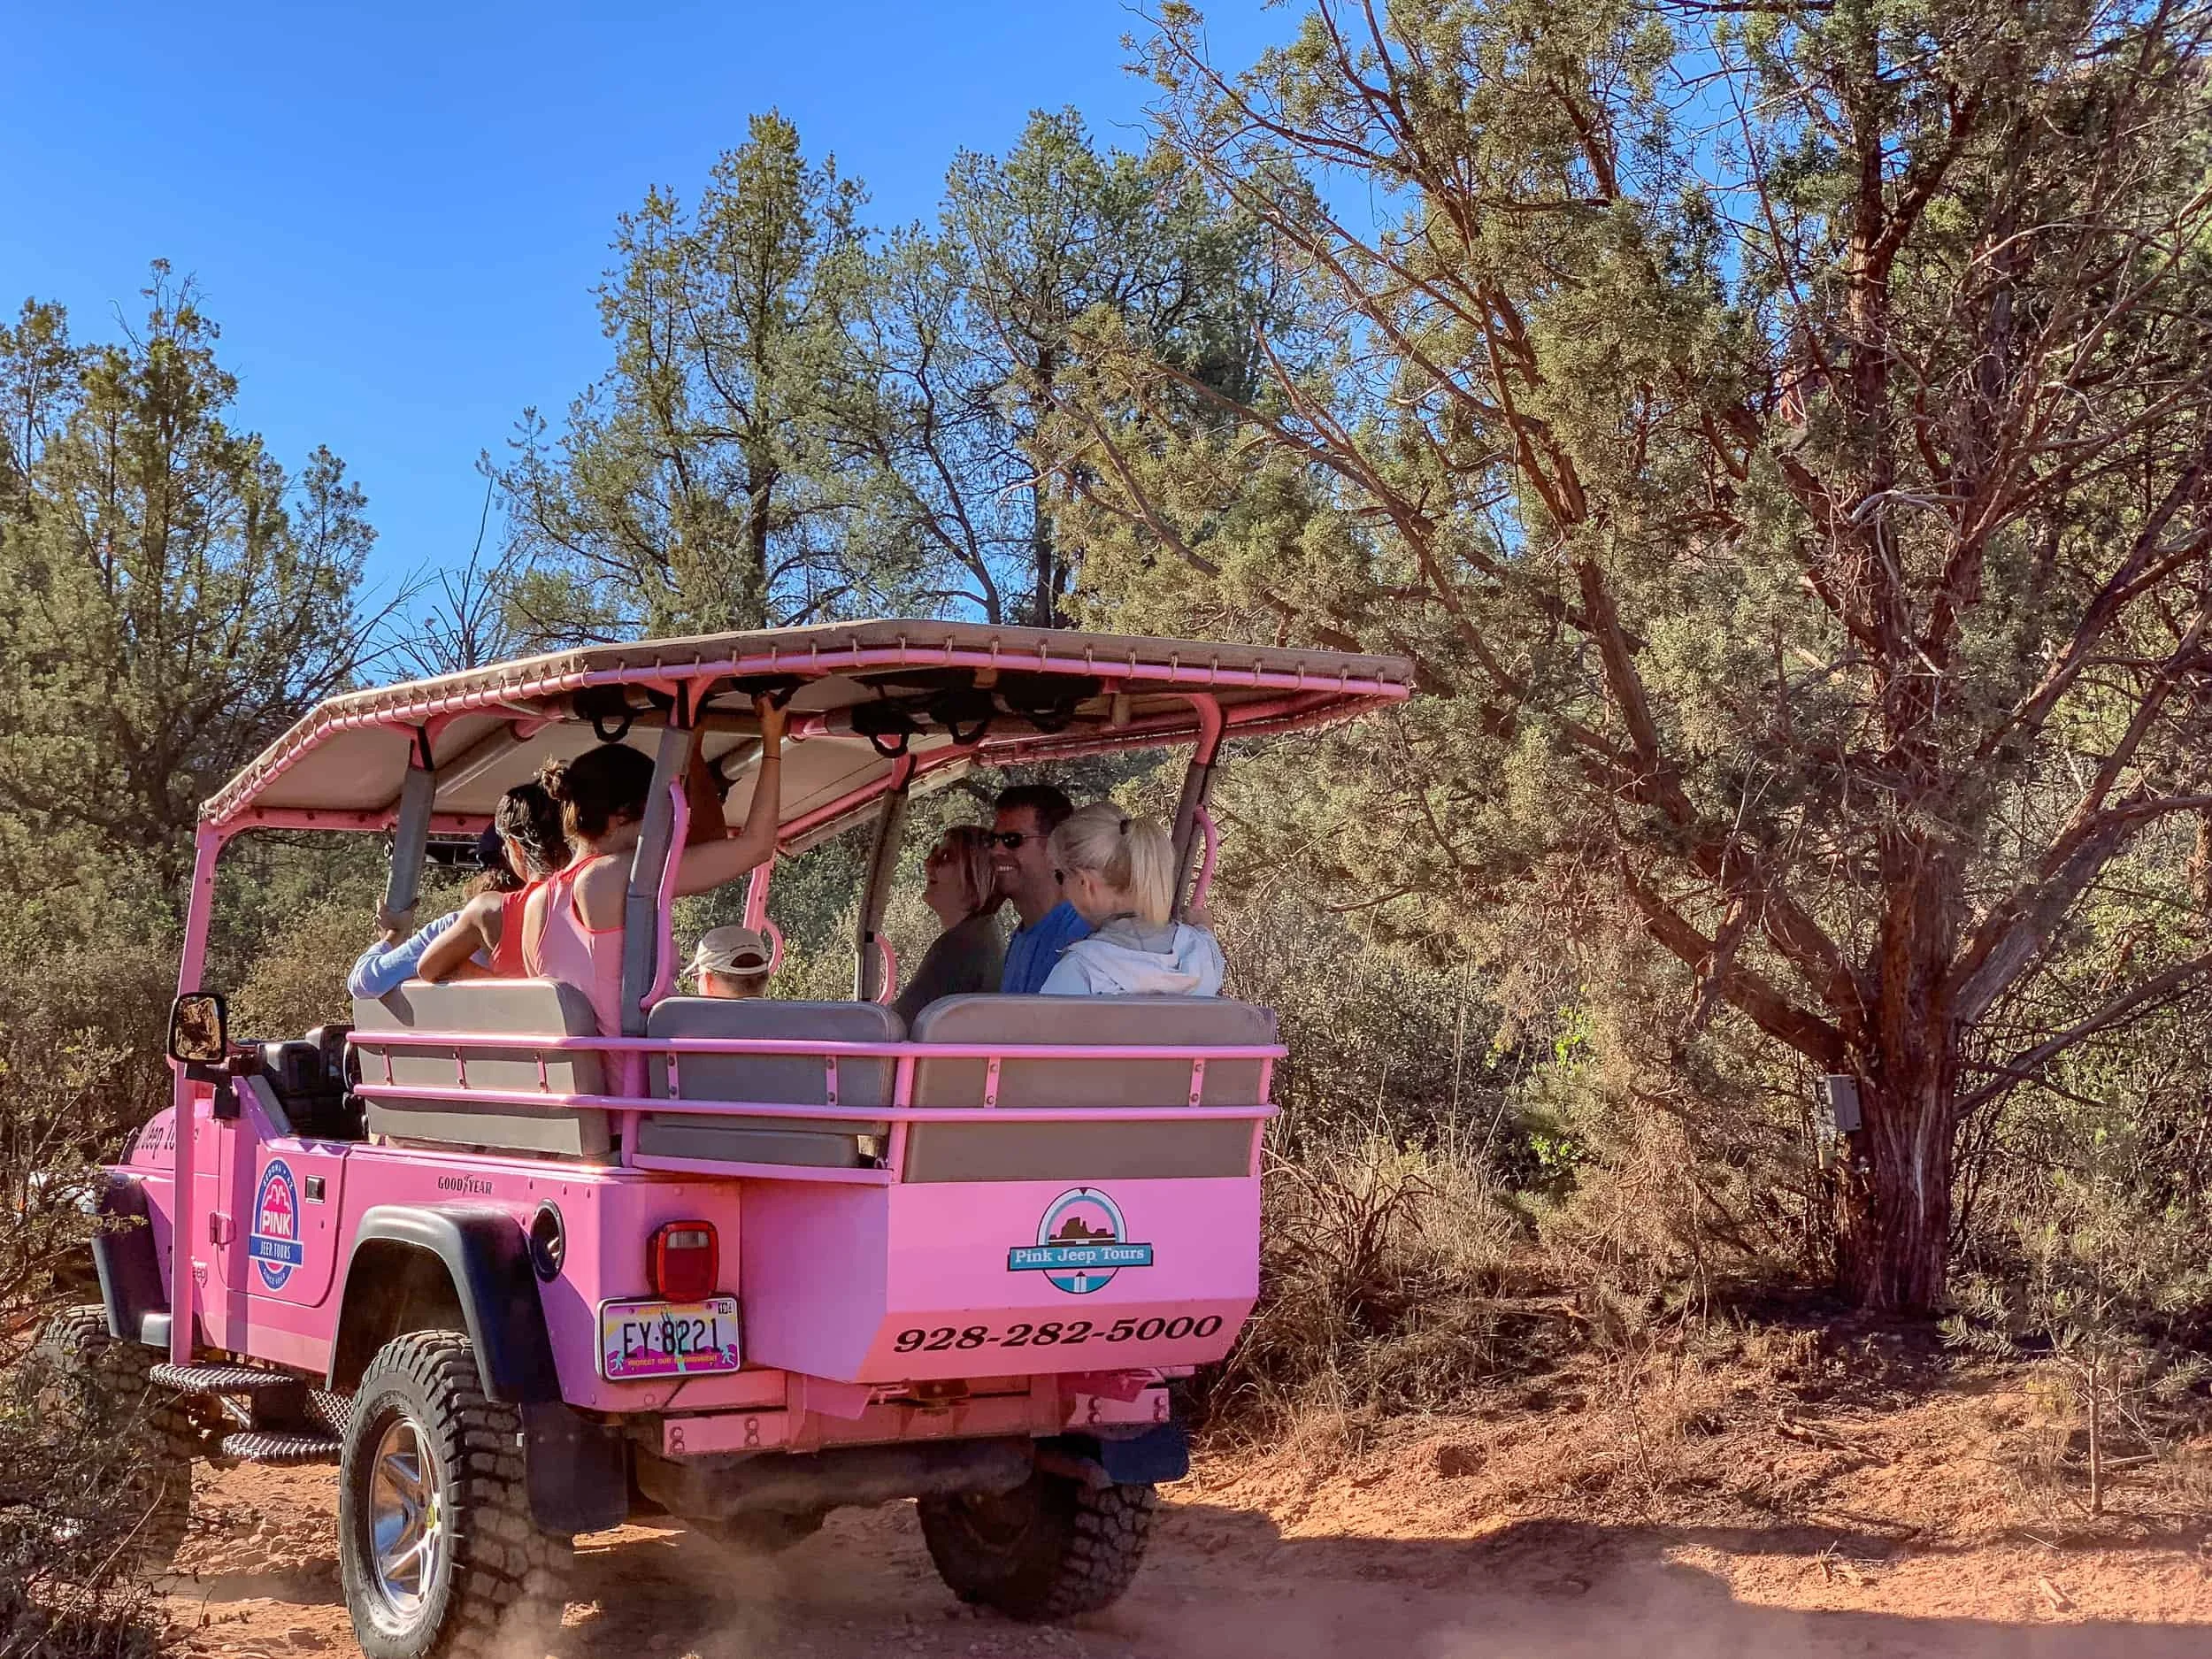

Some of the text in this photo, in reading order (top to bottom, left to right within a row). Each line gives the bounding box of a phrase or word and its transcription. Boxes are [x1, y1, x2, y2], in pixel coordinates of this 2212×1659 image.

[438, 1174, 493, 1195] GOODYEAR
[262, 1210, 291, 1236] PINK
[260, 1240, 291, 1260] JEEP TOURS
[1015, 1246, 1144, 1264] Pink Jeep Tours
[894, 1314, 1223, 1353] 928-282-5000
